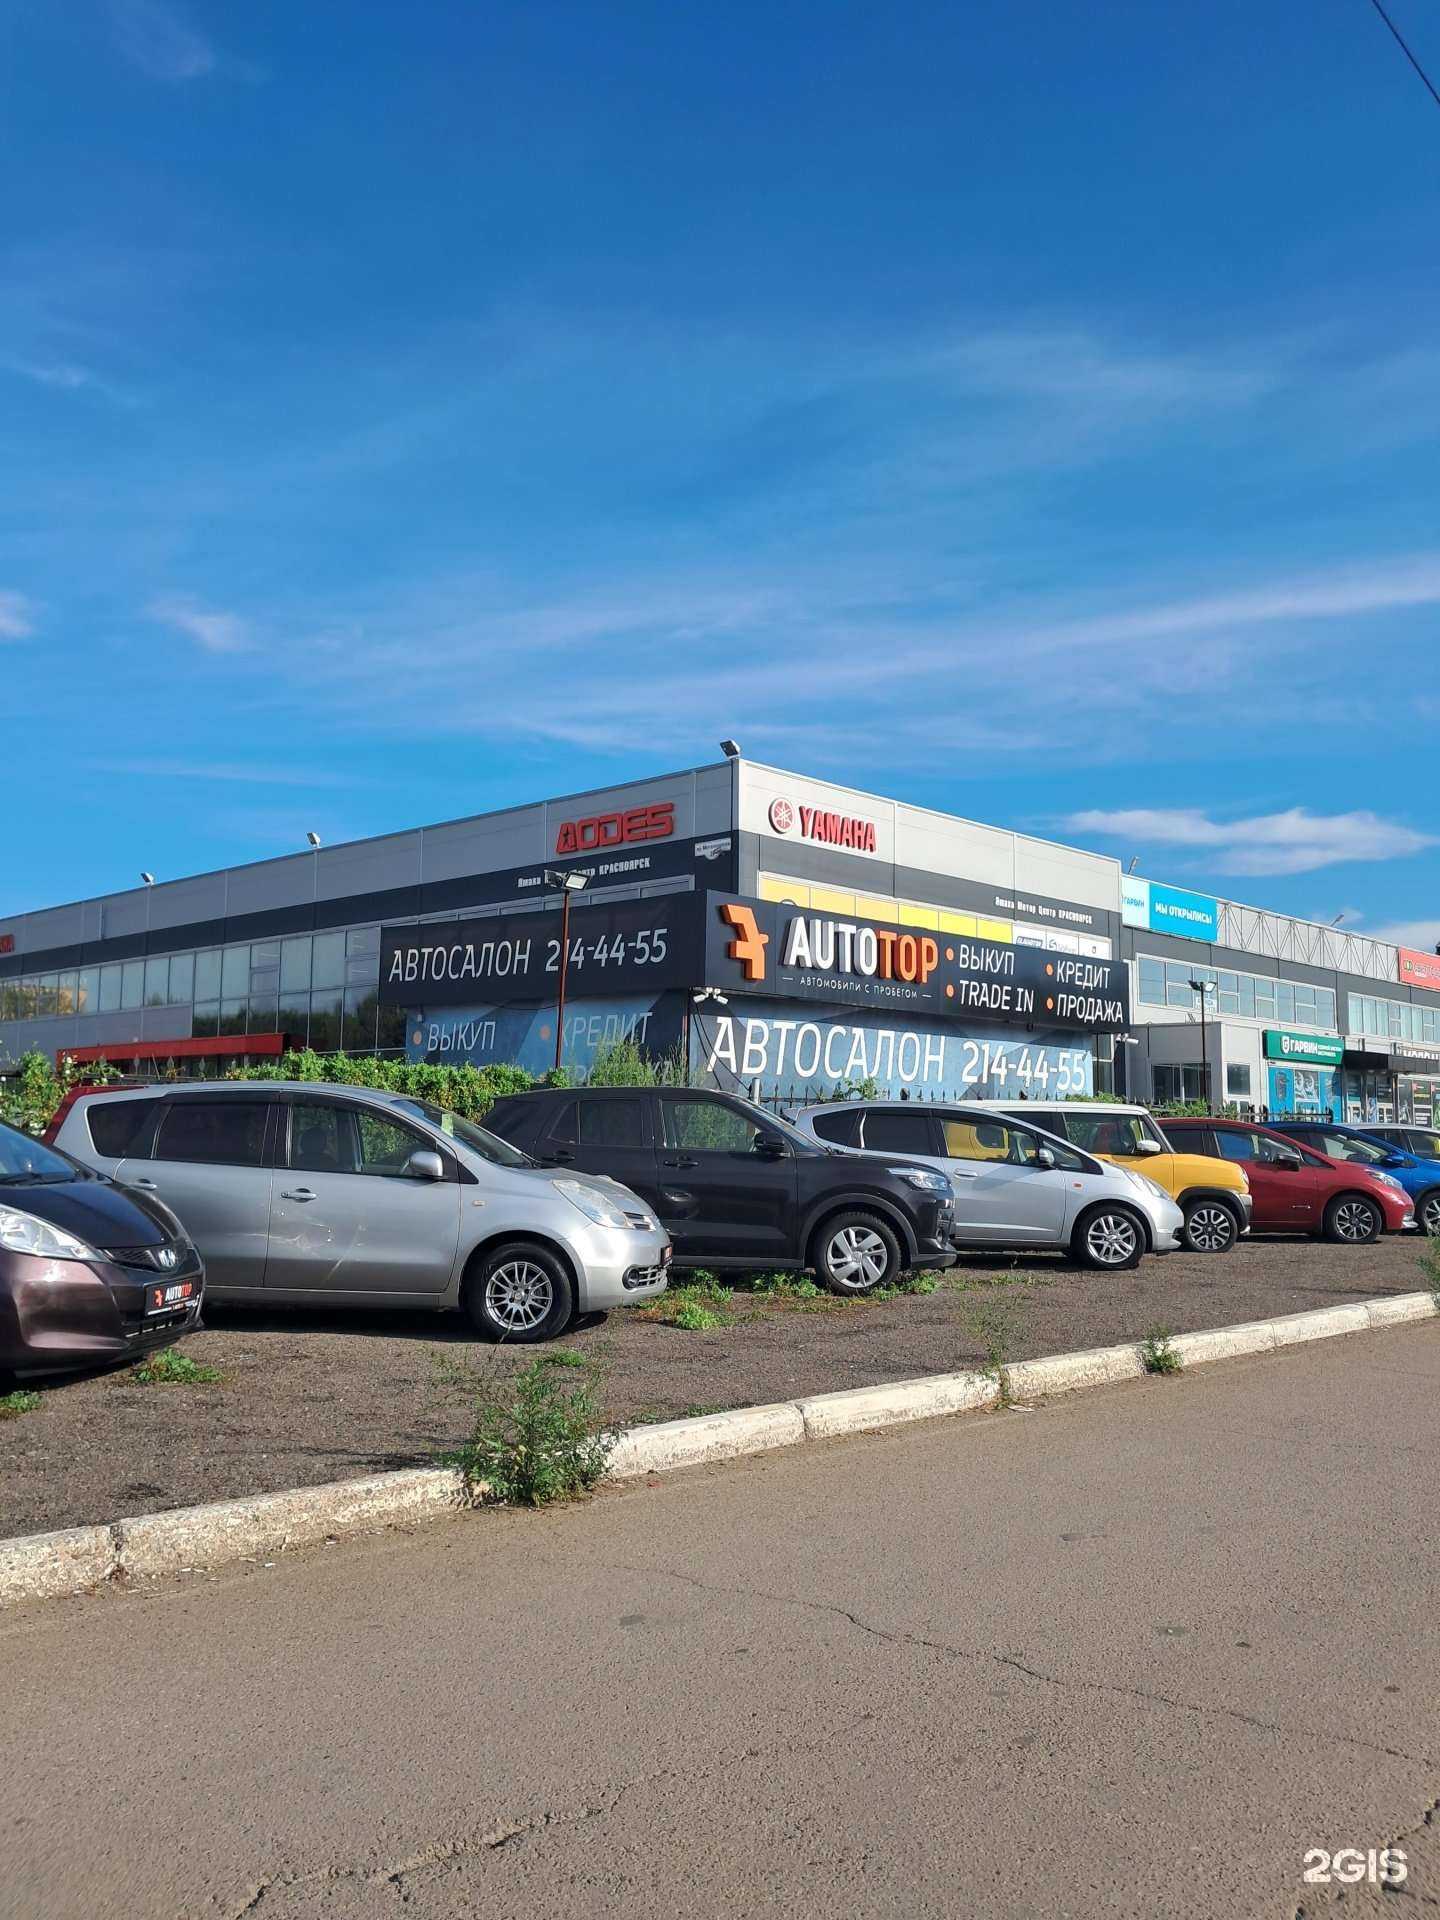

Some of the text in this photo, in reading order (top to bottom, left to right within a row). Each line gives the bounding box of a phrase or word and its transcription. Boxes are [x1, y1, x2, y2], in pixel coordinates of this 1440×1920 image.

[556, 802, 674, 854] AODES
[799, 806, 877, 852] YAMAHA
[599, 857, 650, 875] КРАСНОЯРСК
[1155, 902, 1168, 916] МЫ
[389, 939, 532, 982] АВТОСАЛОН
[784, 916, 938, 983] AUTOTOP
[959, 944, 1015, 975] ВЫКУП
[800, 976, 918, 998] АВТОМОБИЛИ С ПРОБЕГОМ
[1057, 960, 1110, 990] КРЕДИТ
[959, 980, 1034, 1013] TRADE IN
[1057, 994, 1123, 1024] ПРОДАЖА
[427, 1021, 496, 1051] ВЫКУП
[1290, 1039, 1318, 1054] ГАРВИН
[706, 1016, 946, 1082] АВТОСАЛОН
[961, 1040, 1085, 1091] 214-44-55
[165, 1283, 192, 1301] AUTOTOP
